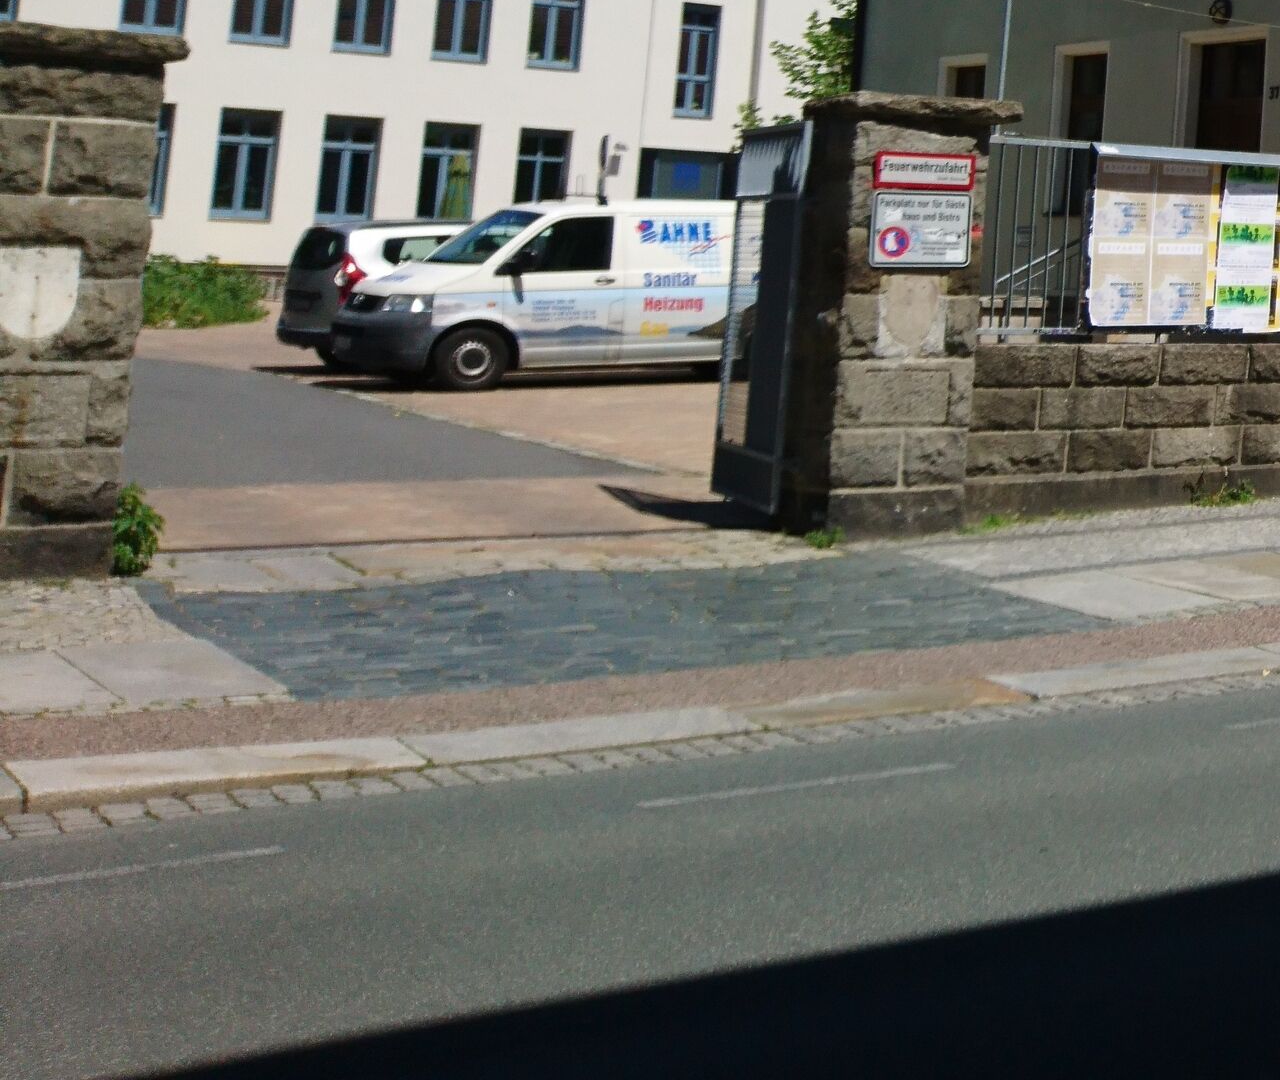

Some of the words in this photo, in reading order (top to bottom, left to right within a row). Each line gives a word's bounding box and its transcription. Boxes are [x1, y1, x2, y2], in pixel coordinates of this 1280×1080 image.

[884, 160, 968, 174] Feuerwehrzufahrt
[643, 272, 697, 288] Sanitär
[643, 298, 704, 313] Heizung
